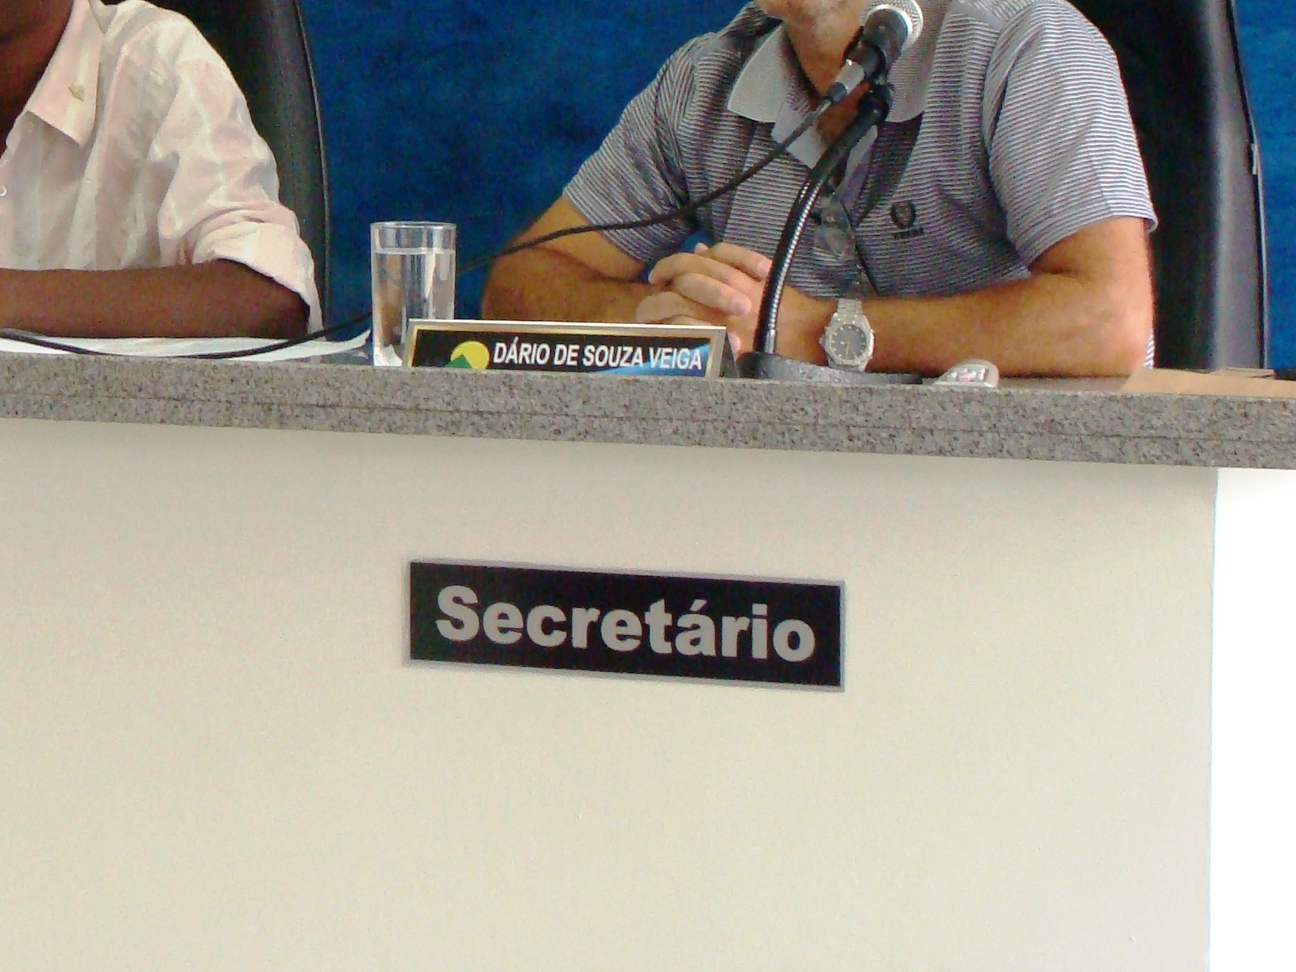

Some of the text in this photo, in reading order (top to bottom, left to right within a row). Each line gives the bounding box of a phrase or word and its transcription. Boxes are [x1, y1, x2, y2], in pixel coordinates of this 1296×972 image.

[493, 336, 703, 370] DÁRIO DE SOUZA VEIGA
[435, 584, 816, 663] Secretário
